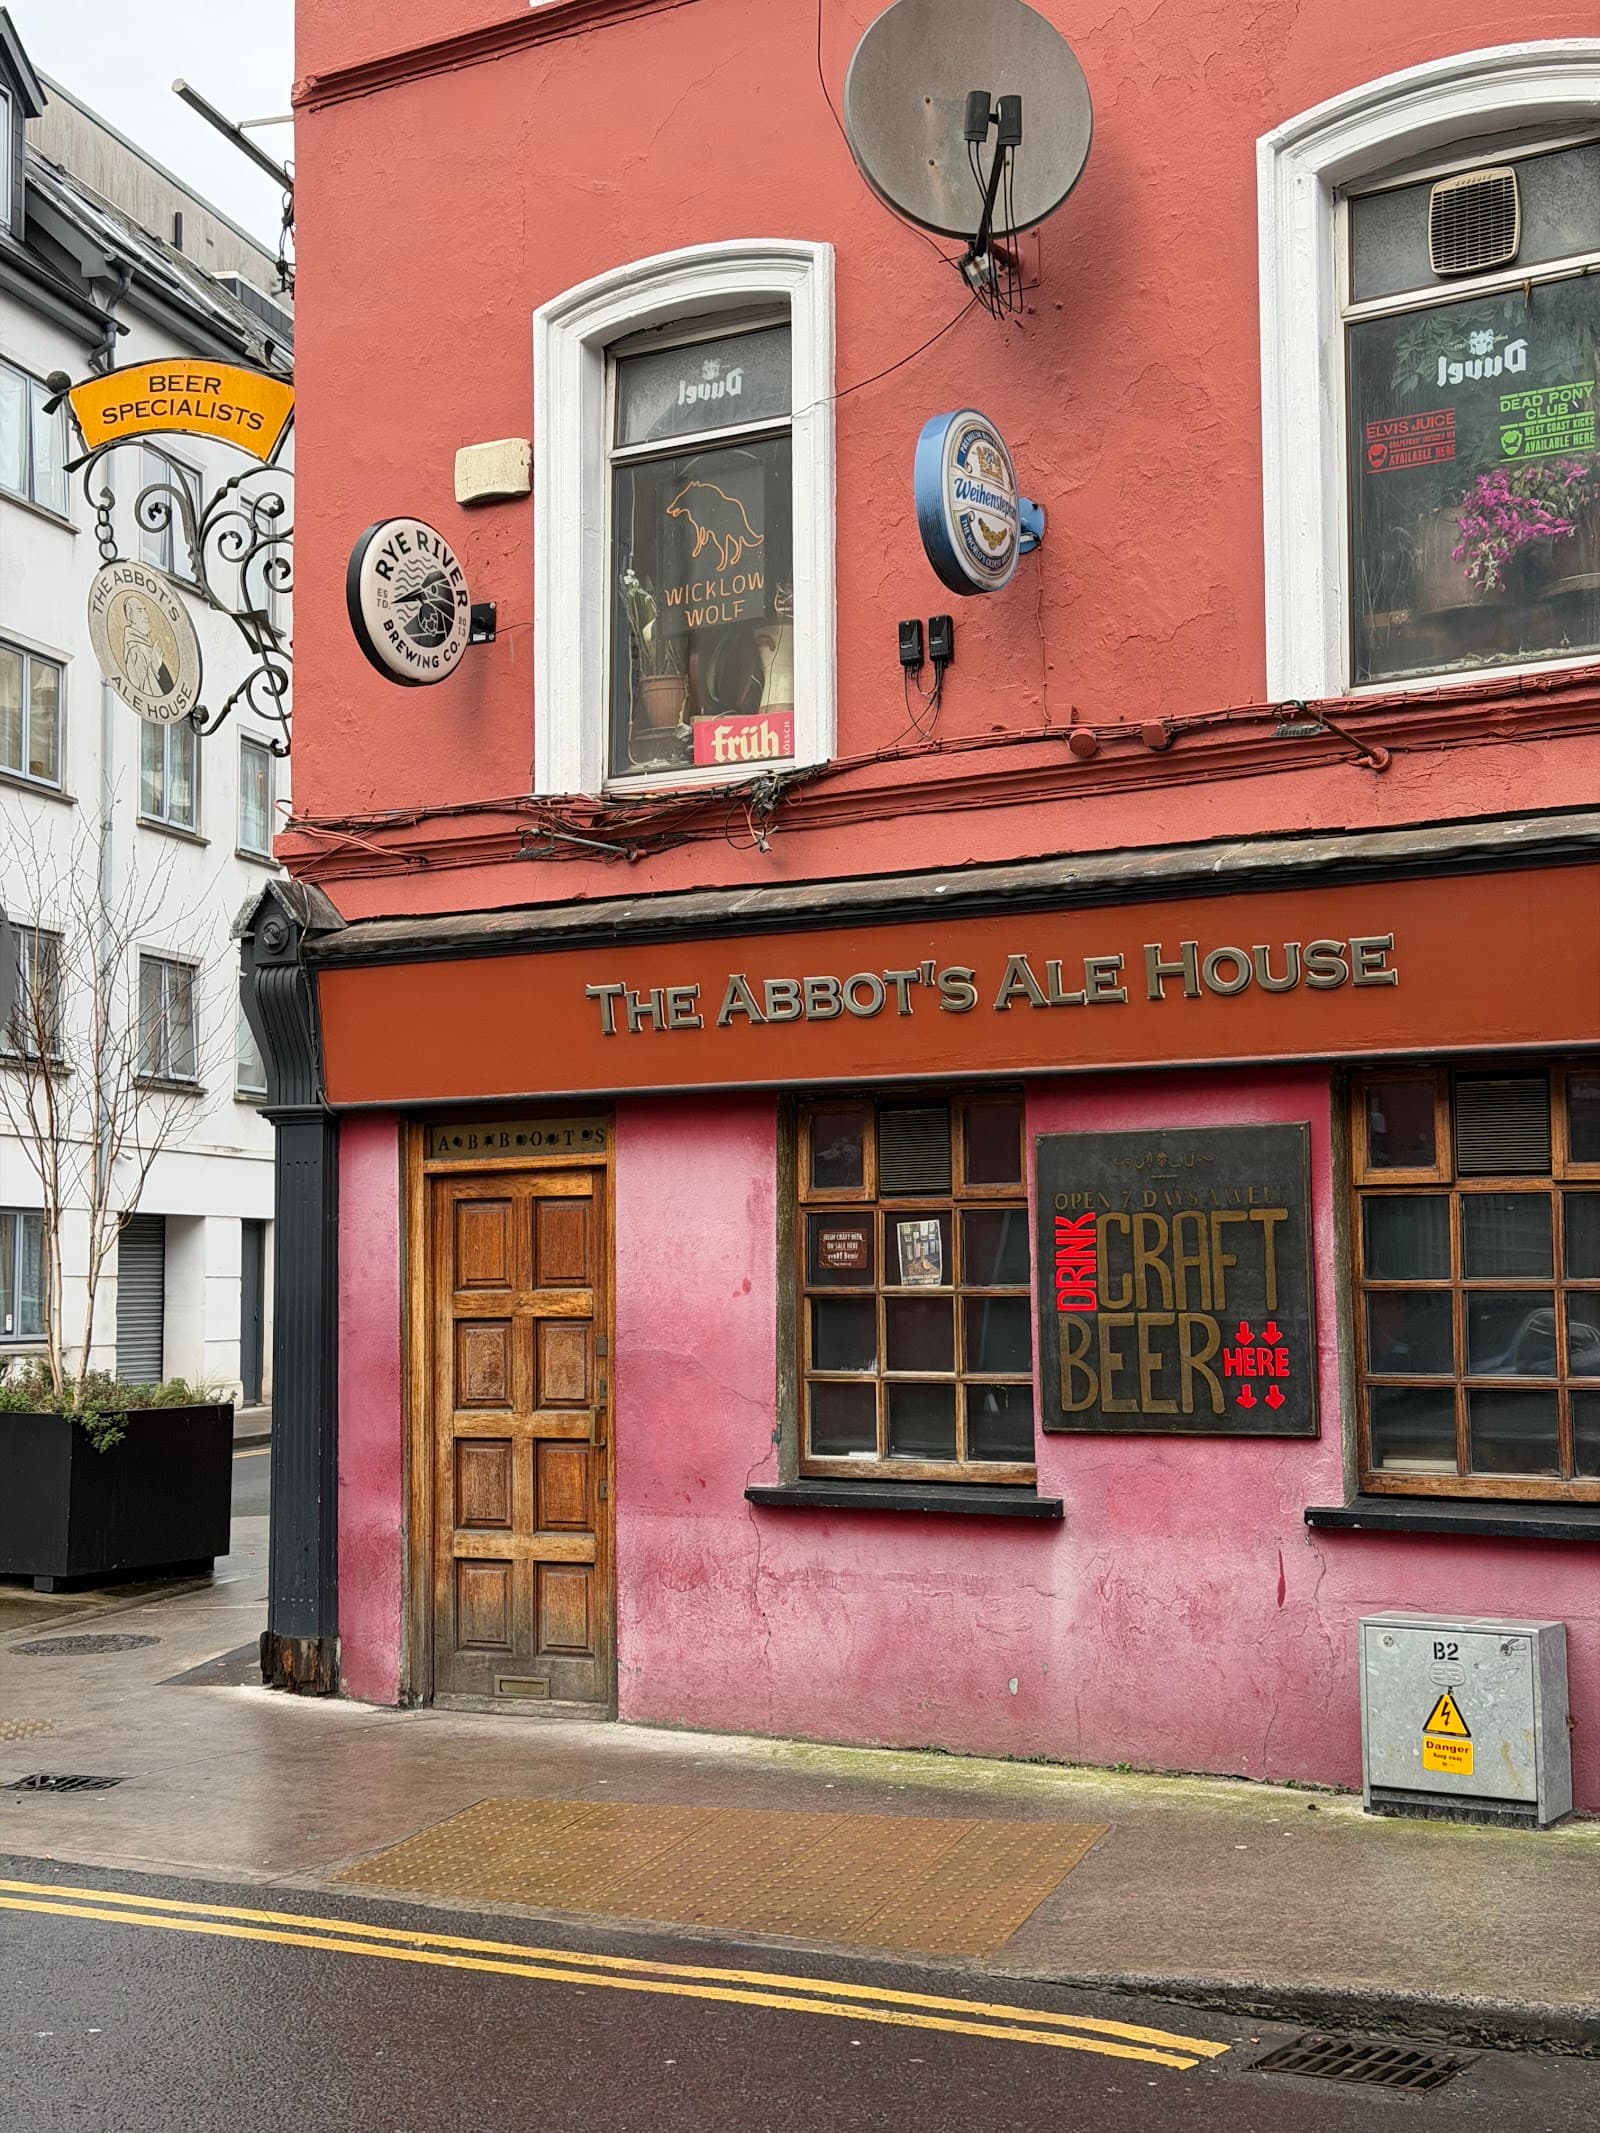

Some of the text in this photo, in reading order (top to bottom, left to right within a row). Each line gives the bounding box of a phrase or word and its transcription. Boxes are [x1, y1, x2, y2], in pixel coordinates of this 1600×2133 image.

[149, 374, 221, 395] BEER
[1500, 386, 1593, 412] DEAD PONY
[102, 399, 265, 430] SPECIALISTS
[1367, 421, 1409, 439] ELVIS
[1411, 412, 1455, 431] JUICE
[1525, 403, 1568, 420] CLUB
[1525, 416, 1594, 436] WEST COAST KICKS
[1525, 431, 1594, 453] AVAILABLE HERE
[1389, 448, 1431, 467] AVAILABLE
[375, 529, 468, 608] RYE RIVER
[92, 569, 180, 622] THE ABBOT'S
[664, 571, 764, 607] WICKLOW
[685, 600, 745, 628] WOLF
[383, 619, 461, 669] BREWING CO.
[112, 676, 193, 720] ALE HOUSE
[711, 719, 779, 763] früh
[585, 932, 1399, 1035] THE ABBOT'S ALE HOUSE
[1054, 1190, 1111, 1210] OPEN
[1055, 1212, 1097, 1312] DRINK
[1096, 1208, 1288, 1311] CRAFT
[1058, 1312, 1225, 1414] BEER
[1223, 1347, 1289, 1377] HERE
[1433, 1641, 1459, 1660] B2
[1426, 1741, 1470, 1754] Danger
